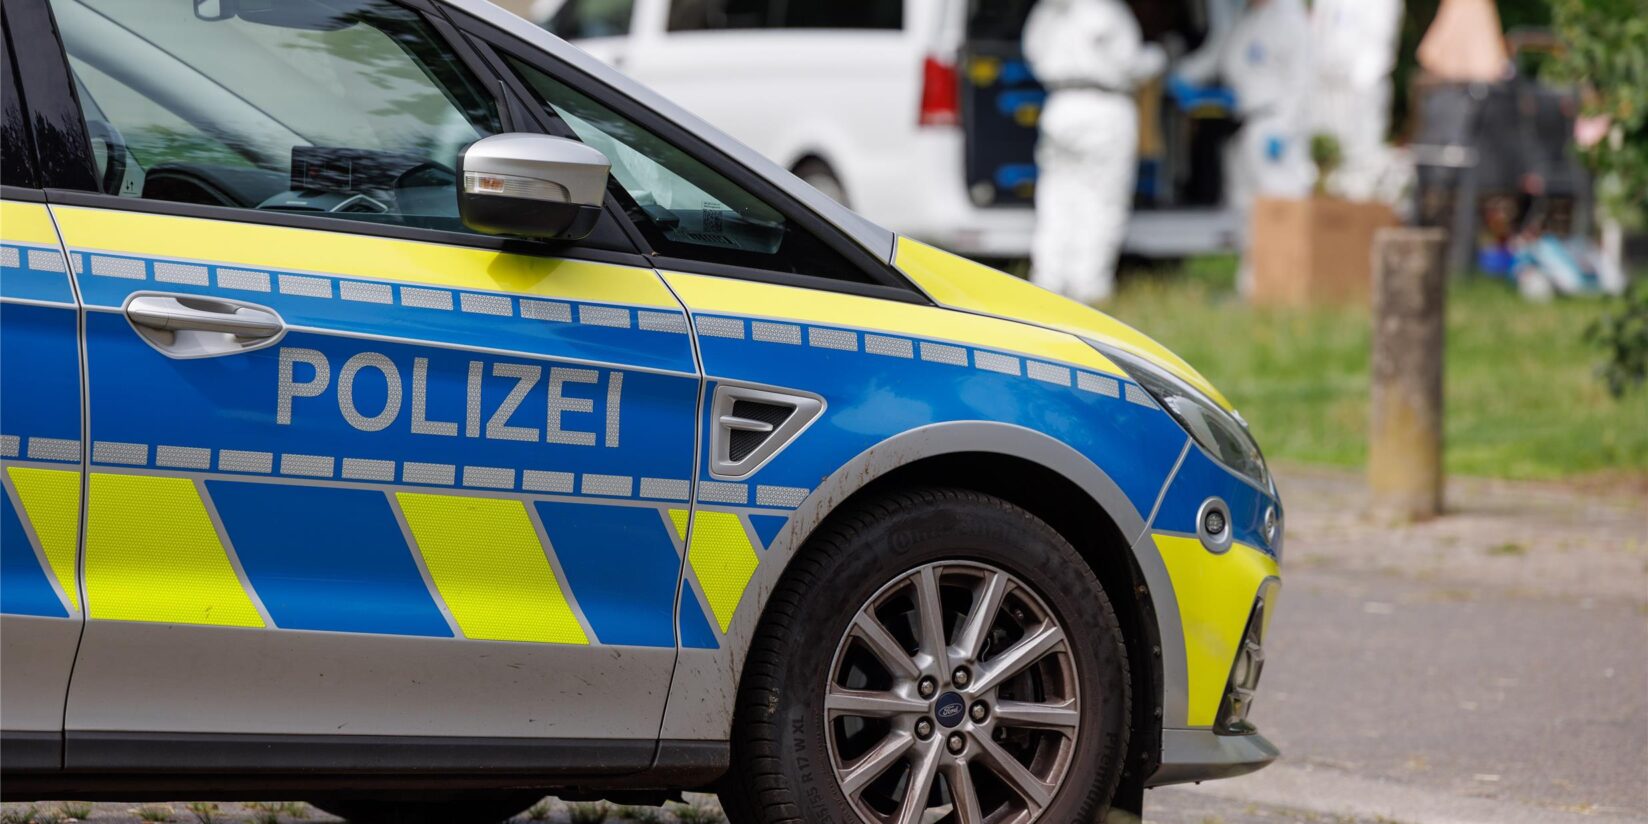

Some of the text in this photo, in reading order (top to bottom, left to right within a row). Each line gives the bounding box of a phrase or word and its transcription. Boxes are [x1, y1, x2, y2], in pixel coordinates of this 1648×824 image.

[276, 345, 624, 448] POLIZEI
[942, 704, 960, 716] Ford
[792, 715, 804, 734] XL
[793, 738, 806, 752] W
[797, 756, 810, 771] 17
[801, 771, 814, 783] R
